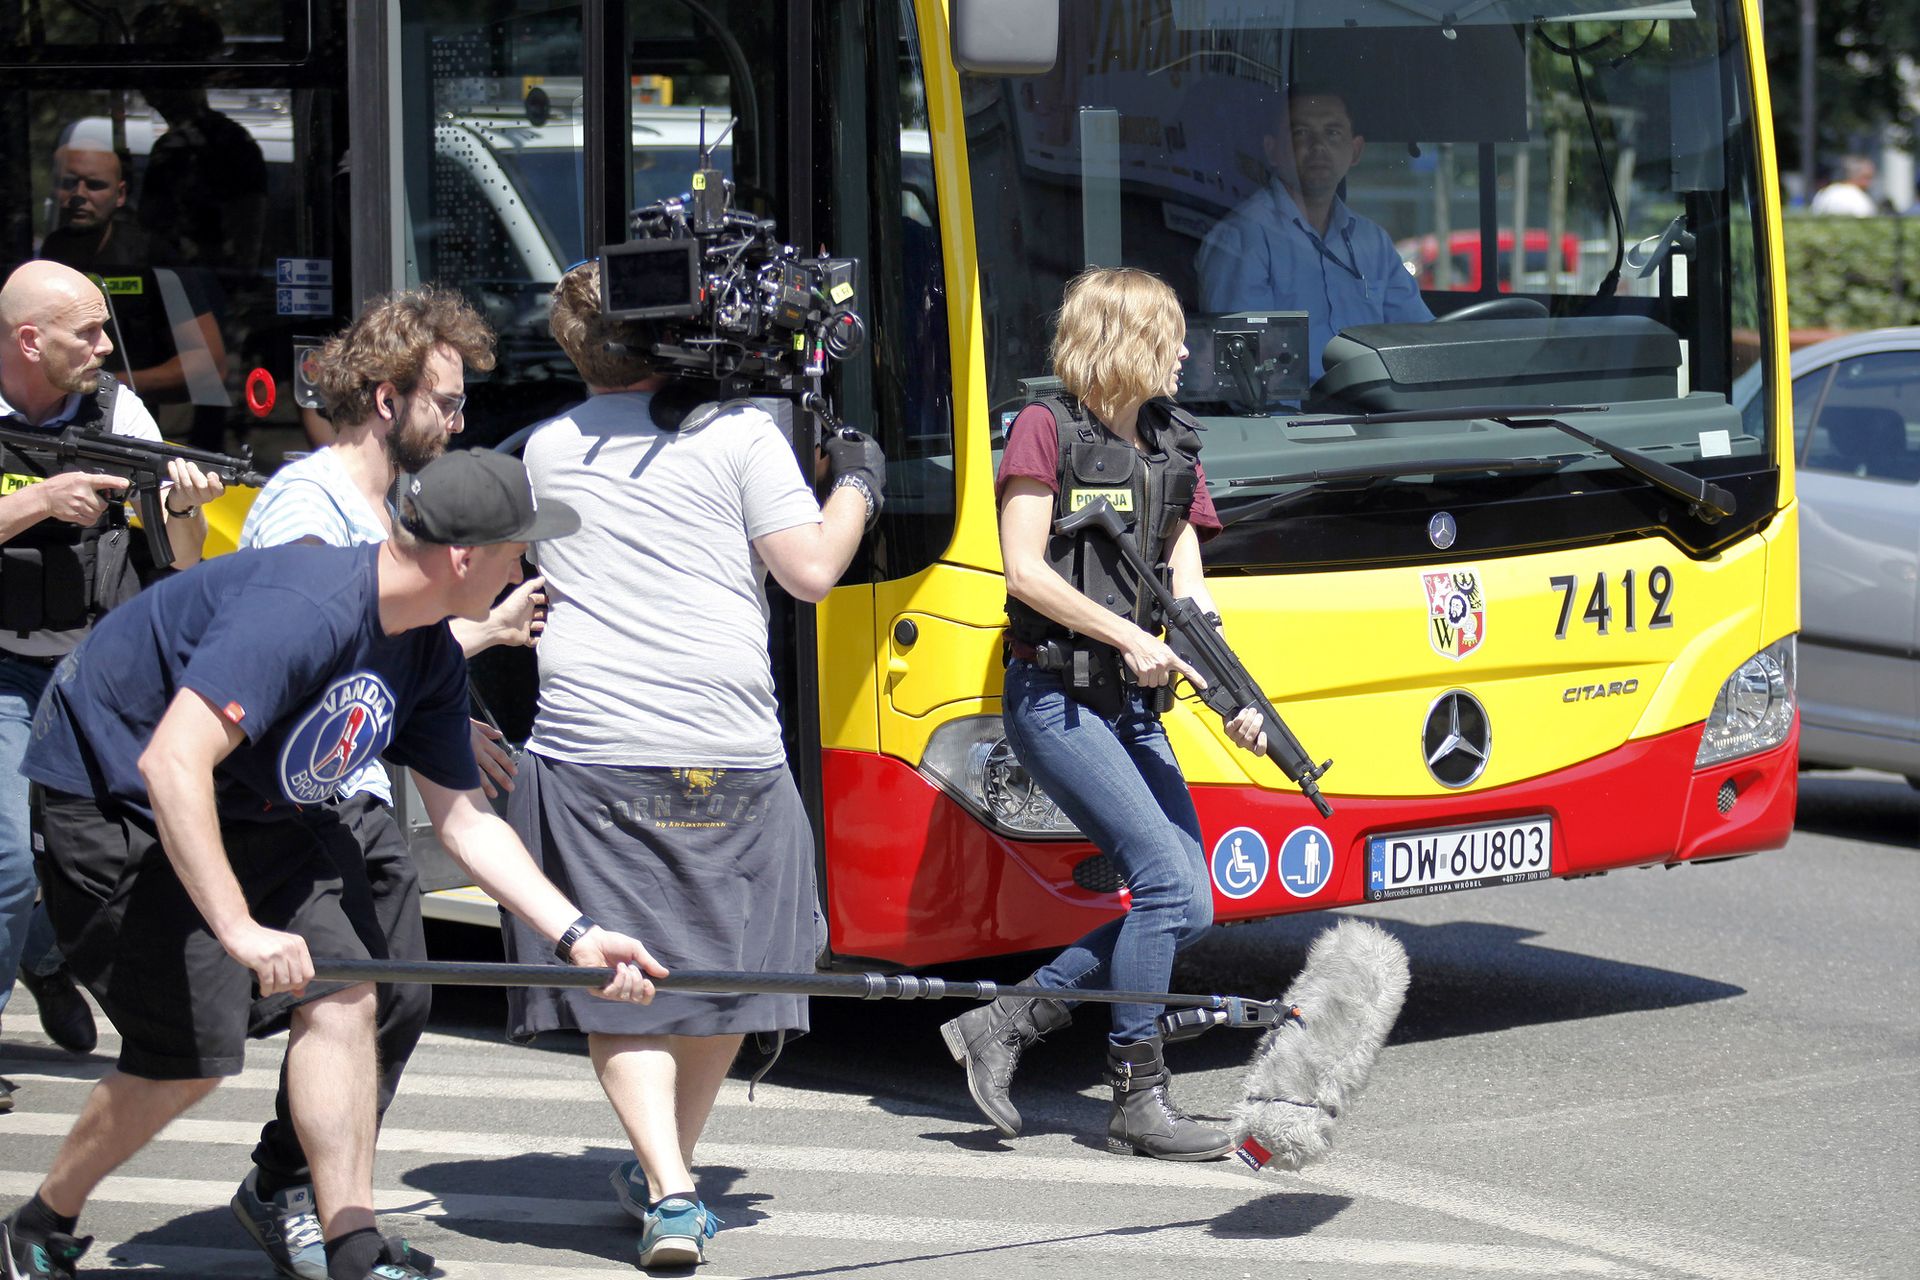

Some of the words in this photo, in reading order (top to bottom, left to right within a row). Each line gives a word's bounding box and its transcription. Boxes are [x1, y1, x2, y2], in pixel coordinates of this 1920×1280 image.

[1549, 565, 1674, 640] 7412
[323, 679, 392, 733] VANDAL
[1563, 679, 1638, 703] CITARO
[1391, 838, 1438, 884] DW
[1451, 826, 1543, 876] 6U803
[1372, 871, 1384, 883] PL
[1429, 883, 1452, 893] GRUPA
[1454, 880, 1482, 891] WRÓBEL
